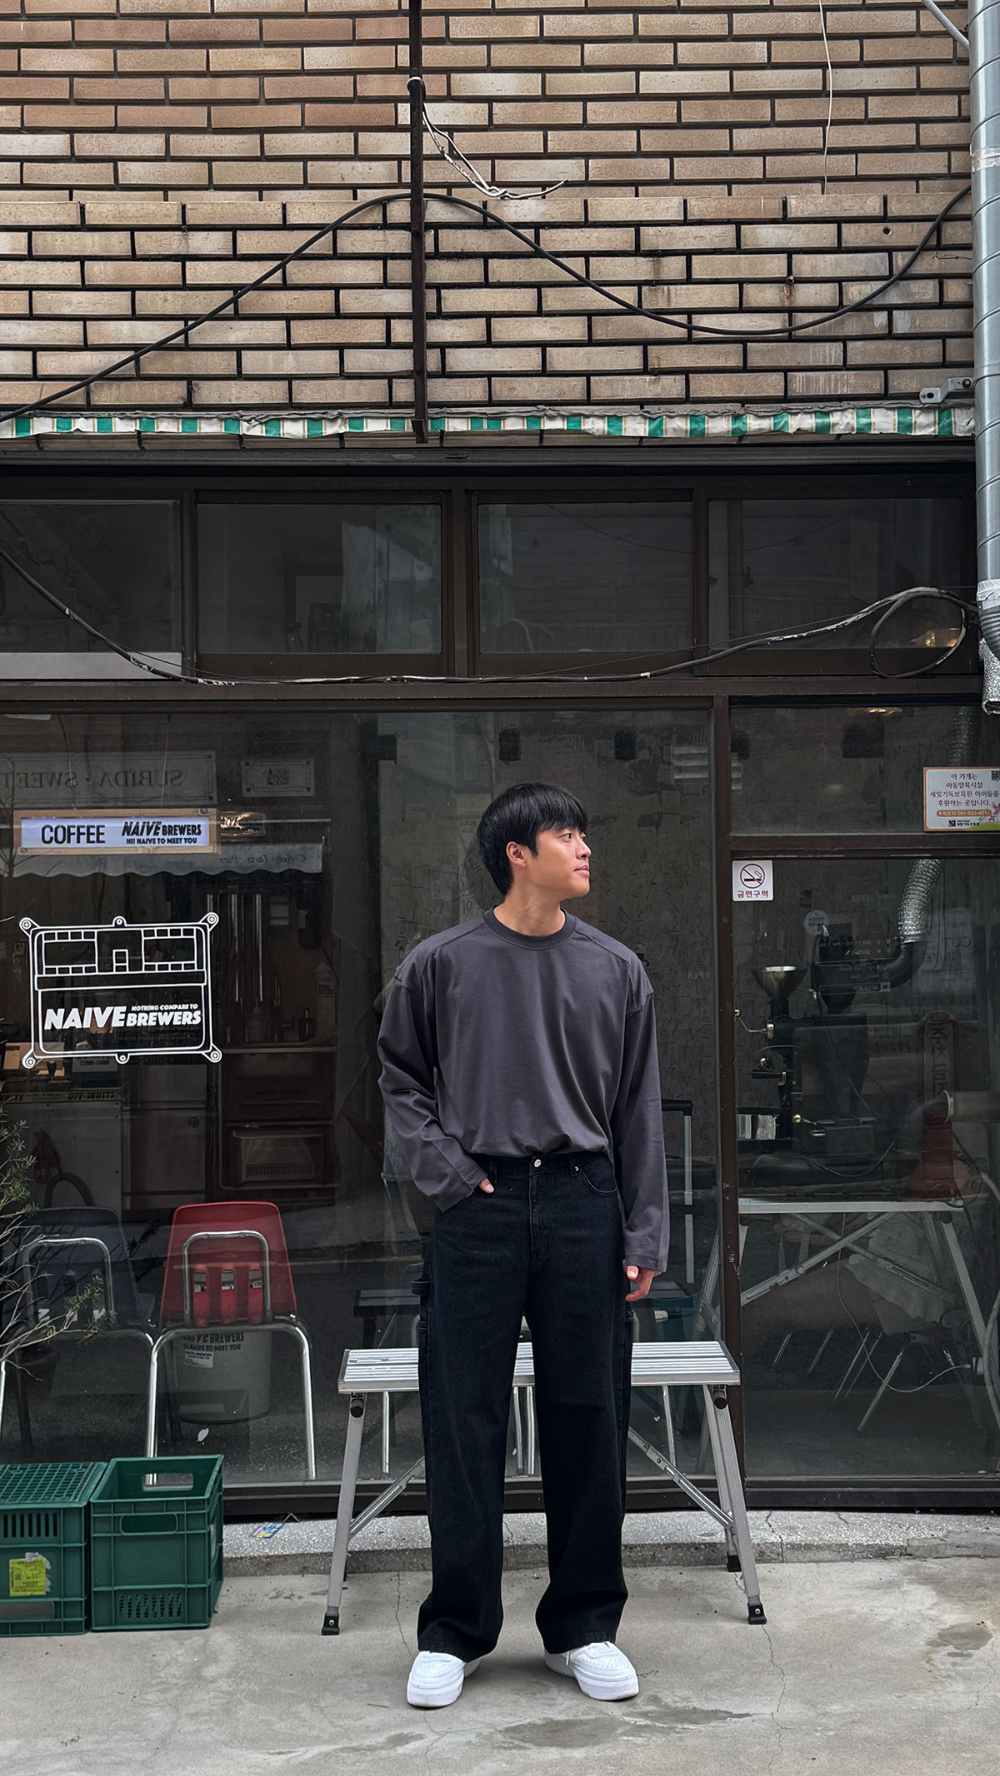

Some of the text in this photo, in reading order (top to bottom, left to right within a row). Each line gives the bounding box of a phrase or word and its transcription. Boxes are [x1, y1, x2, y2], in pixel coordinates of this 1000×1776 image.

[974, 790, 999, 798] 아이들을
[937, 799, 991, 807] 후원하는 곳입니다.
[41, 820, 202, 845] COFFEE NAIVE BREWERS
[737, 890, 769, 899] 금연구역
[44, 1006, 202, 1030] NAIVE BREWERS
[68, 1091, 116, 1100] OFF-WHITE
[209, 1331, 244, 1343] BREWERS
